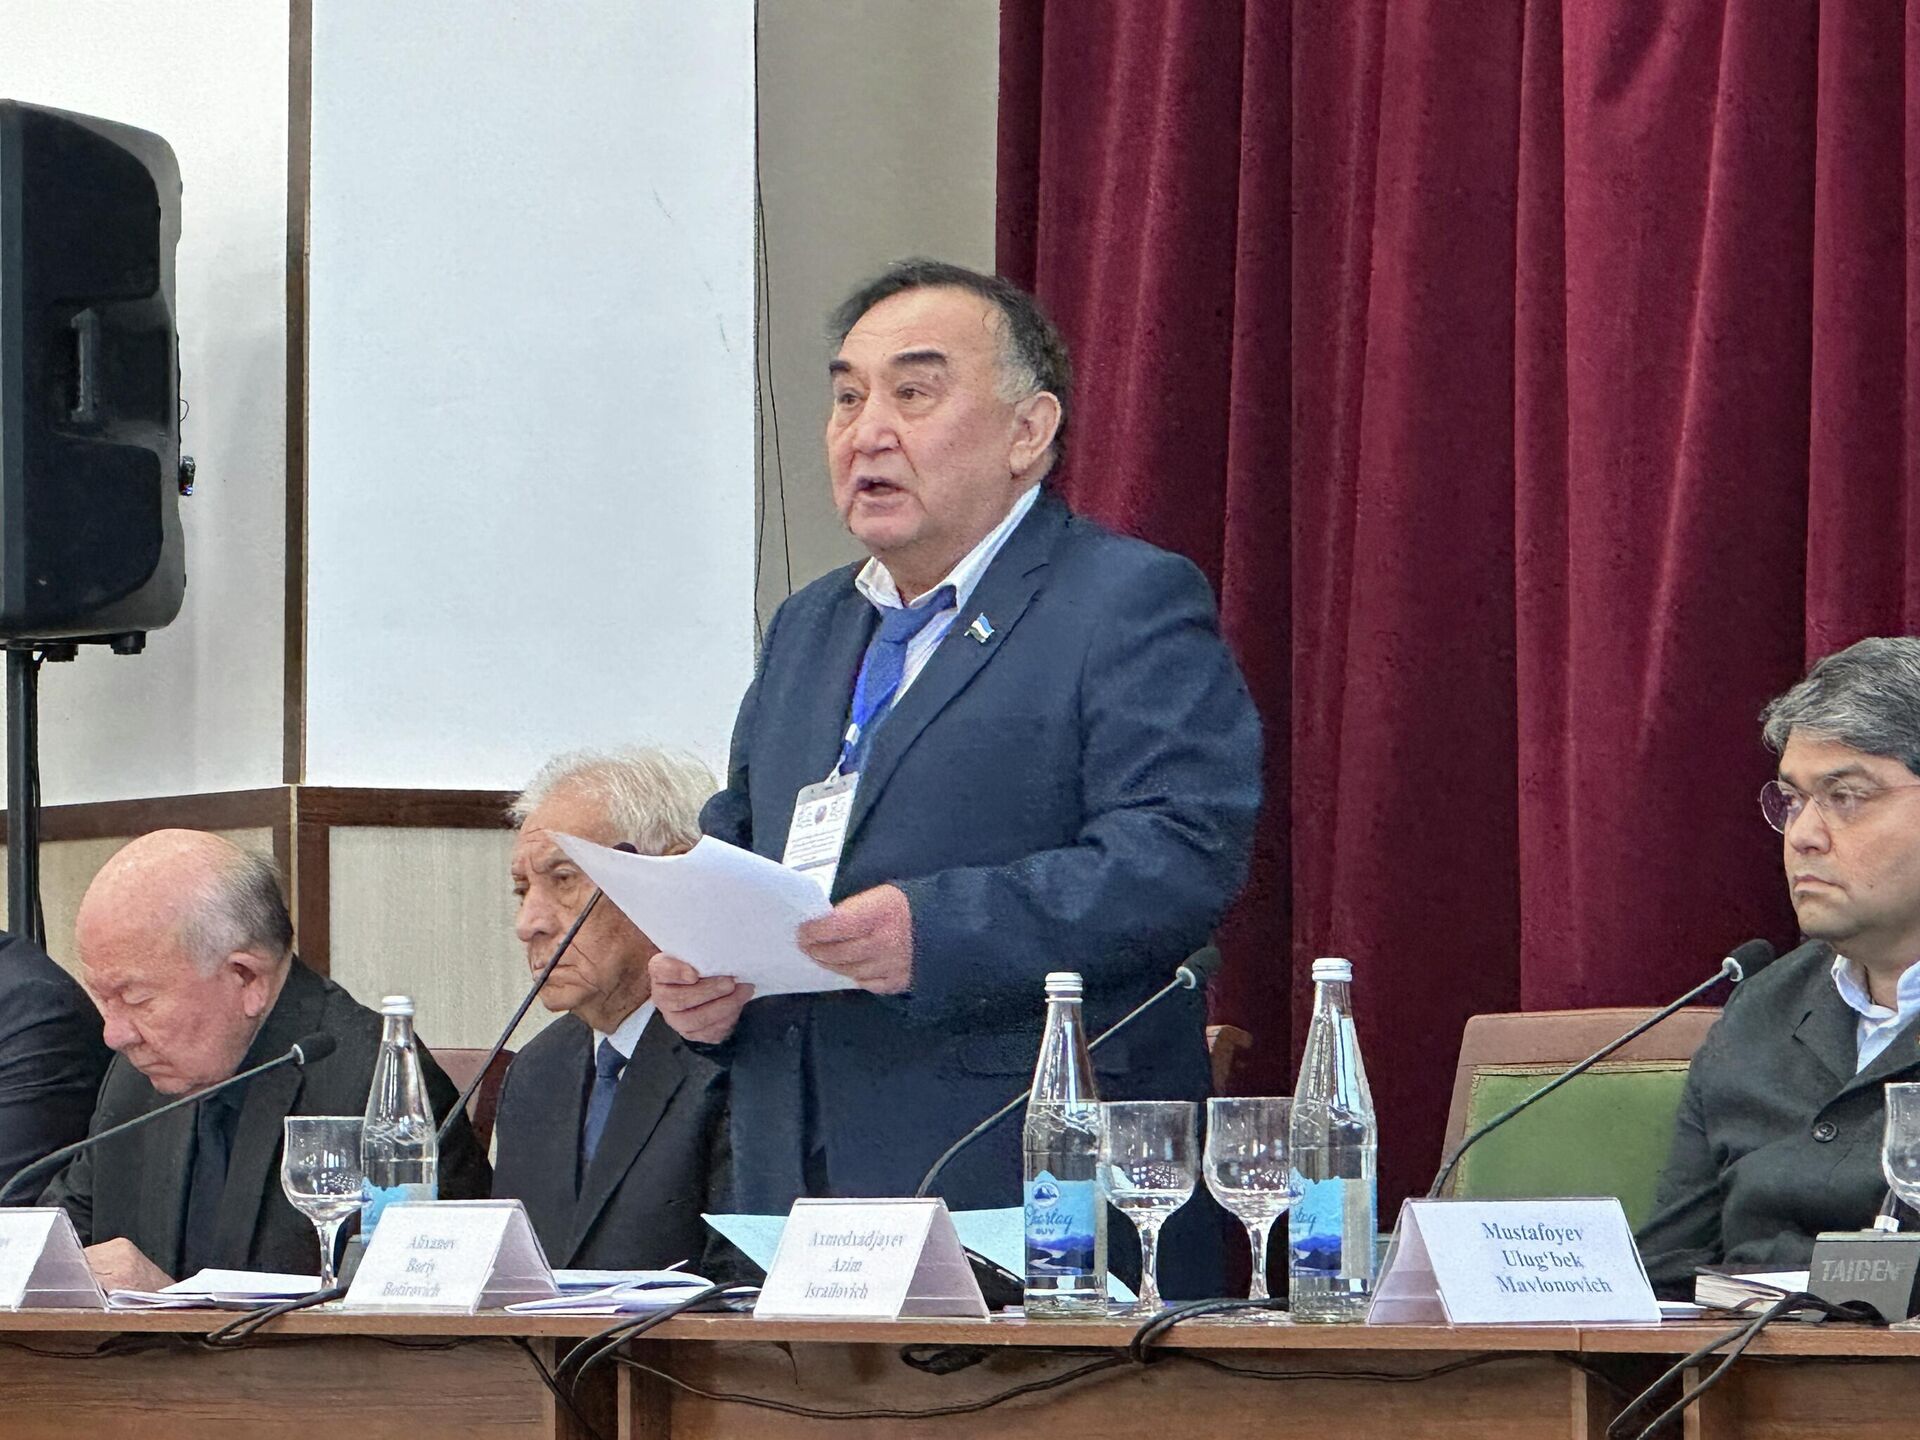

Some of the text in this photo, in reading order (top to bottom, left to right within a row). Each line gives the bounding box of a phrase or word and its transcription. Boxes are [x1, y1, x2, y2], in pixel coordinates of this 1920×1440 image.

[1481, 1222, 1583, 1245] Mustafoyev
[828, 1256, 863, 1272] Azim
[1502, 1250, 1585, 1272] Ulug'bek
[1496, 1275, 1613, 1293] Mavlonovich
